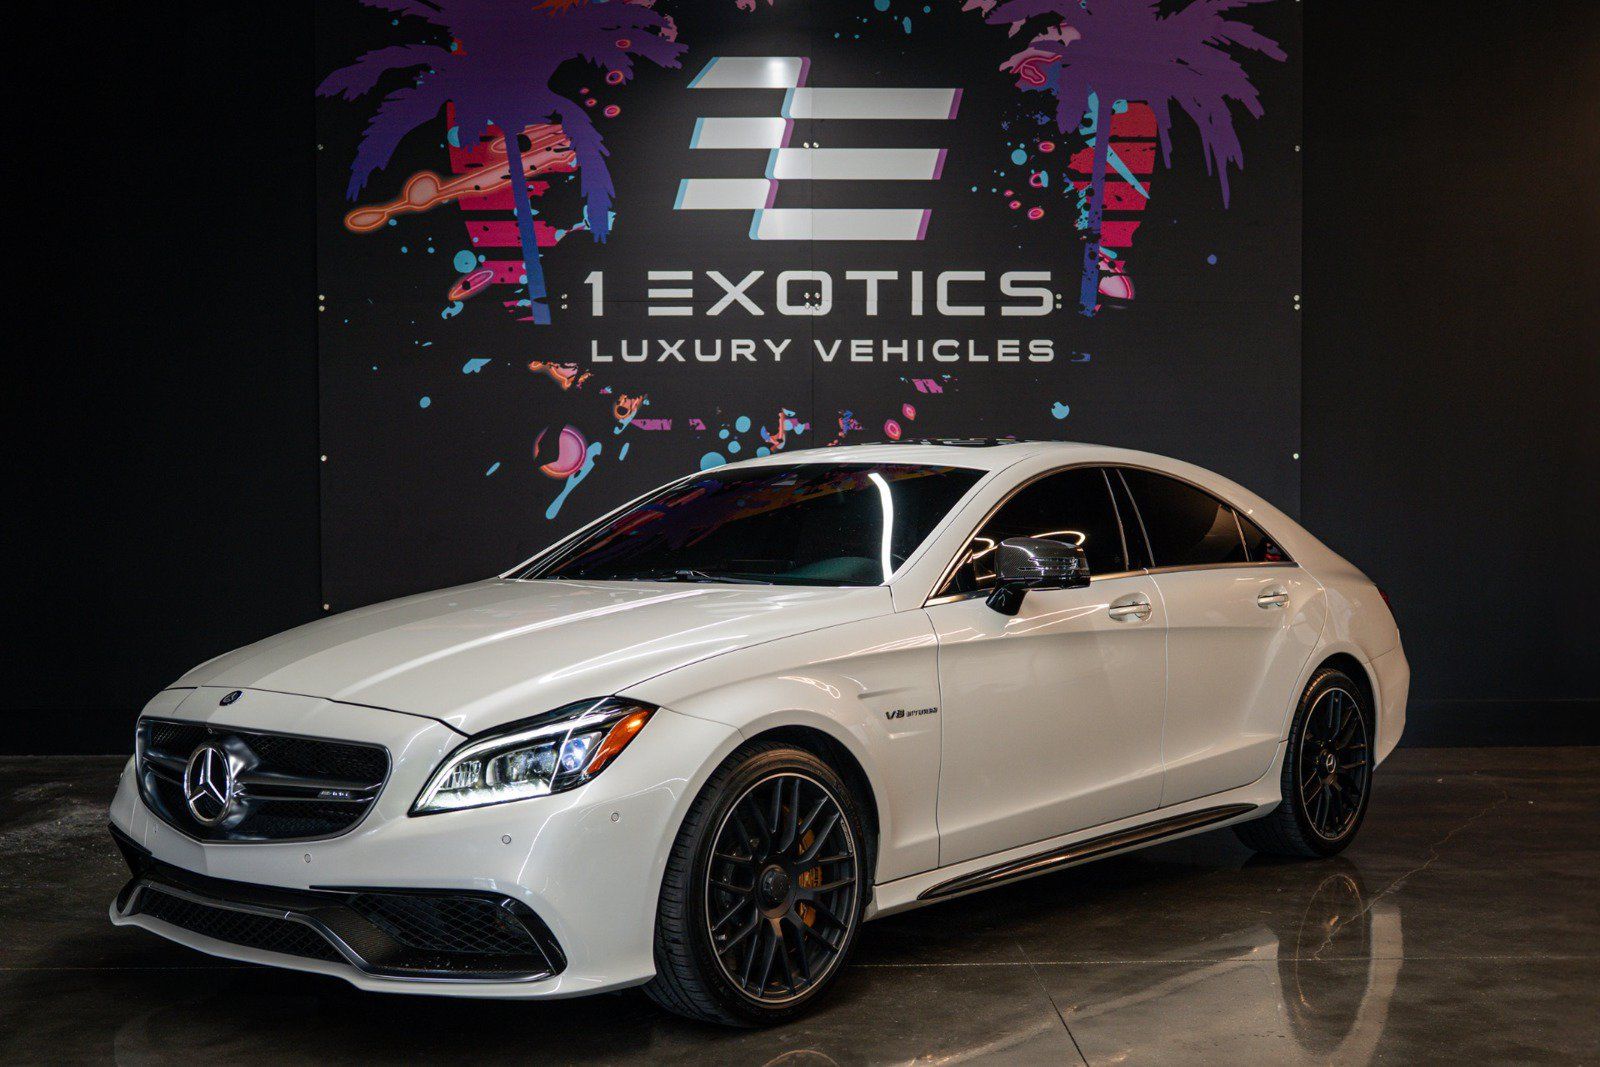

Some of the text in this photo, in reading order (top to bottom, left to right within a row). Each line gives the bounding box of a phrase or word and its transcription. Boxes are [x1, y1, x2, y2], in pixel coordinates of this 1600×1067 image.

[584, 271, 1054, 316] 1 EXOTICS
[591, 339, 1055, 362] LUXURY VEHICLES
